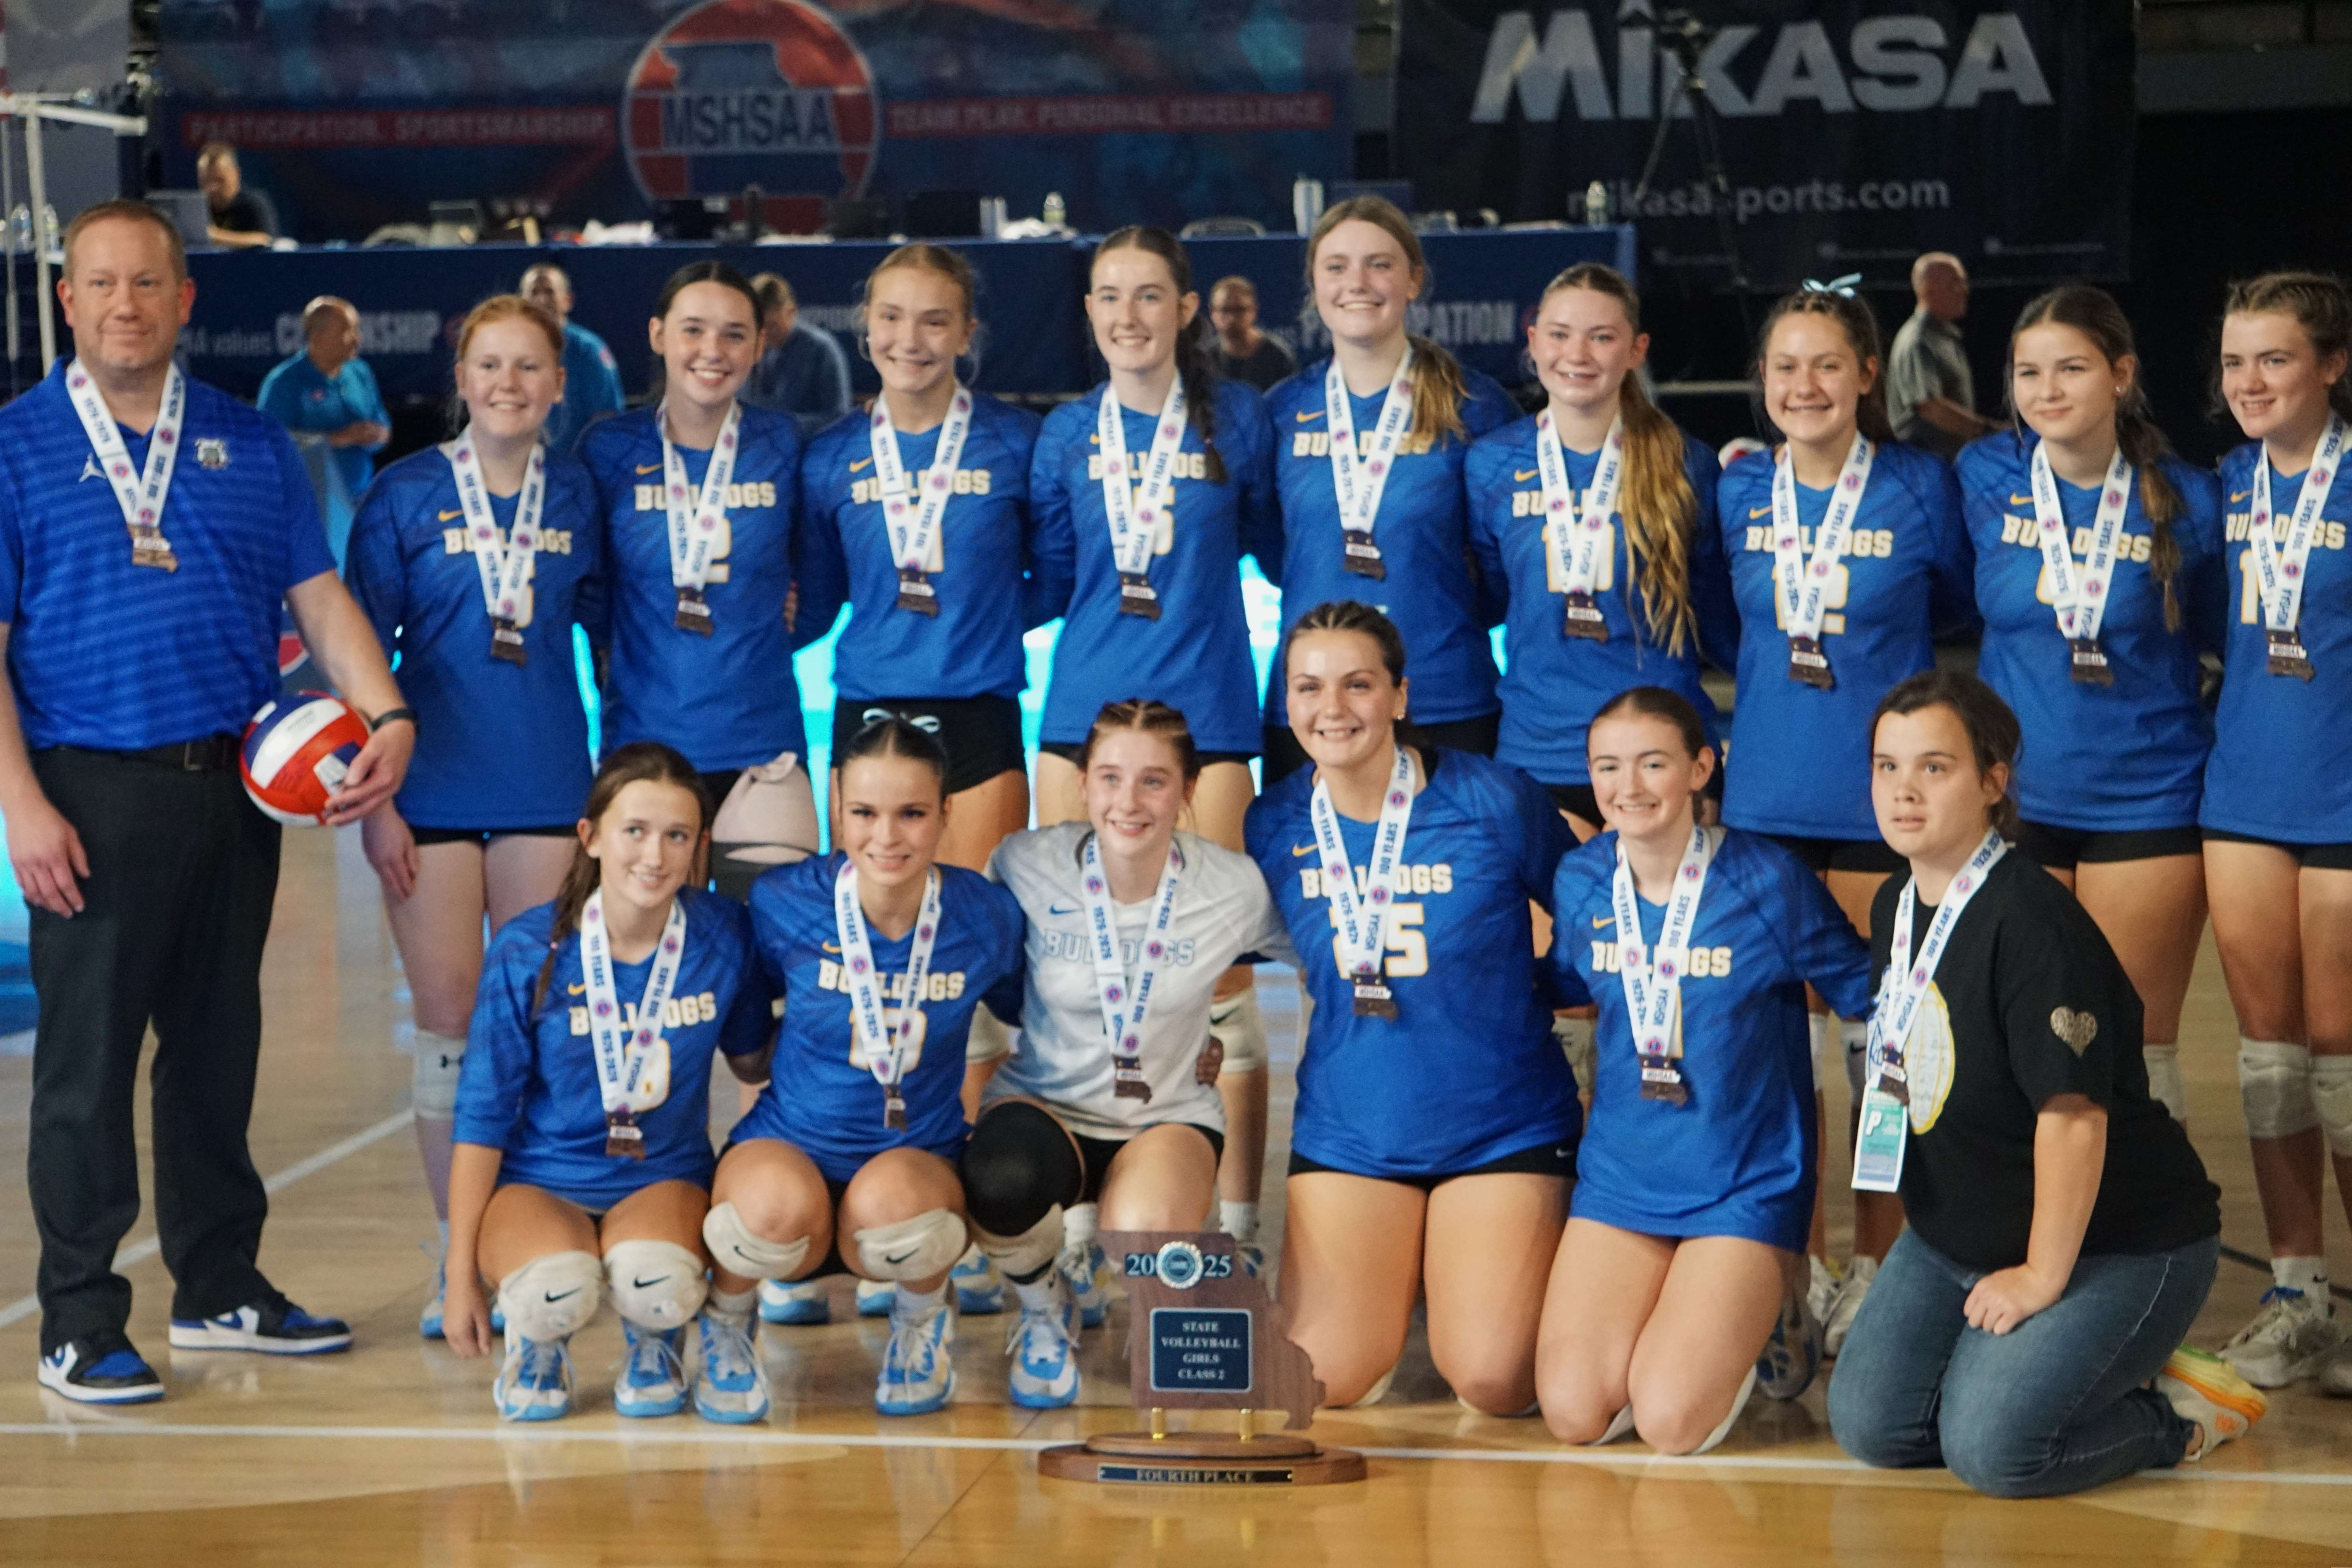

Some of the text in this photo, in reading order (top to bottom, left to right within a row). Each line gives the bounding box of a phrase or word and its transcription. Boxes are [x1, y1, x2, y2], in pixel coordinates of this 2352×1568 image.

[665, 95, 832, 144] MSHSAA
[1567, 176, 1951, 224] mikasaports.com
[1320, 816, 1336, 851] YEARS
[1384, 822, 1398, 854] YEARS
[1619, 899, 1632, 936] YEARS
[1675, 895, 1691, 928] YEARS
[1934, 906, 1954, 939] YEARS
[1865, 1111, 1882, 1136] P
[1126, 1254, 1232, 1277] 20 25
[1183, 1321, 1219, 1332] STATE
[1161, 1337, 1241, 1349] VOLLEYBALL
[1183, 1353, 1221, 1364] GIRLS
[1178, 1368, 1225, 1380] CLASS 2
[1137, 1469, 1257, 1483] FOURTH PLACE
